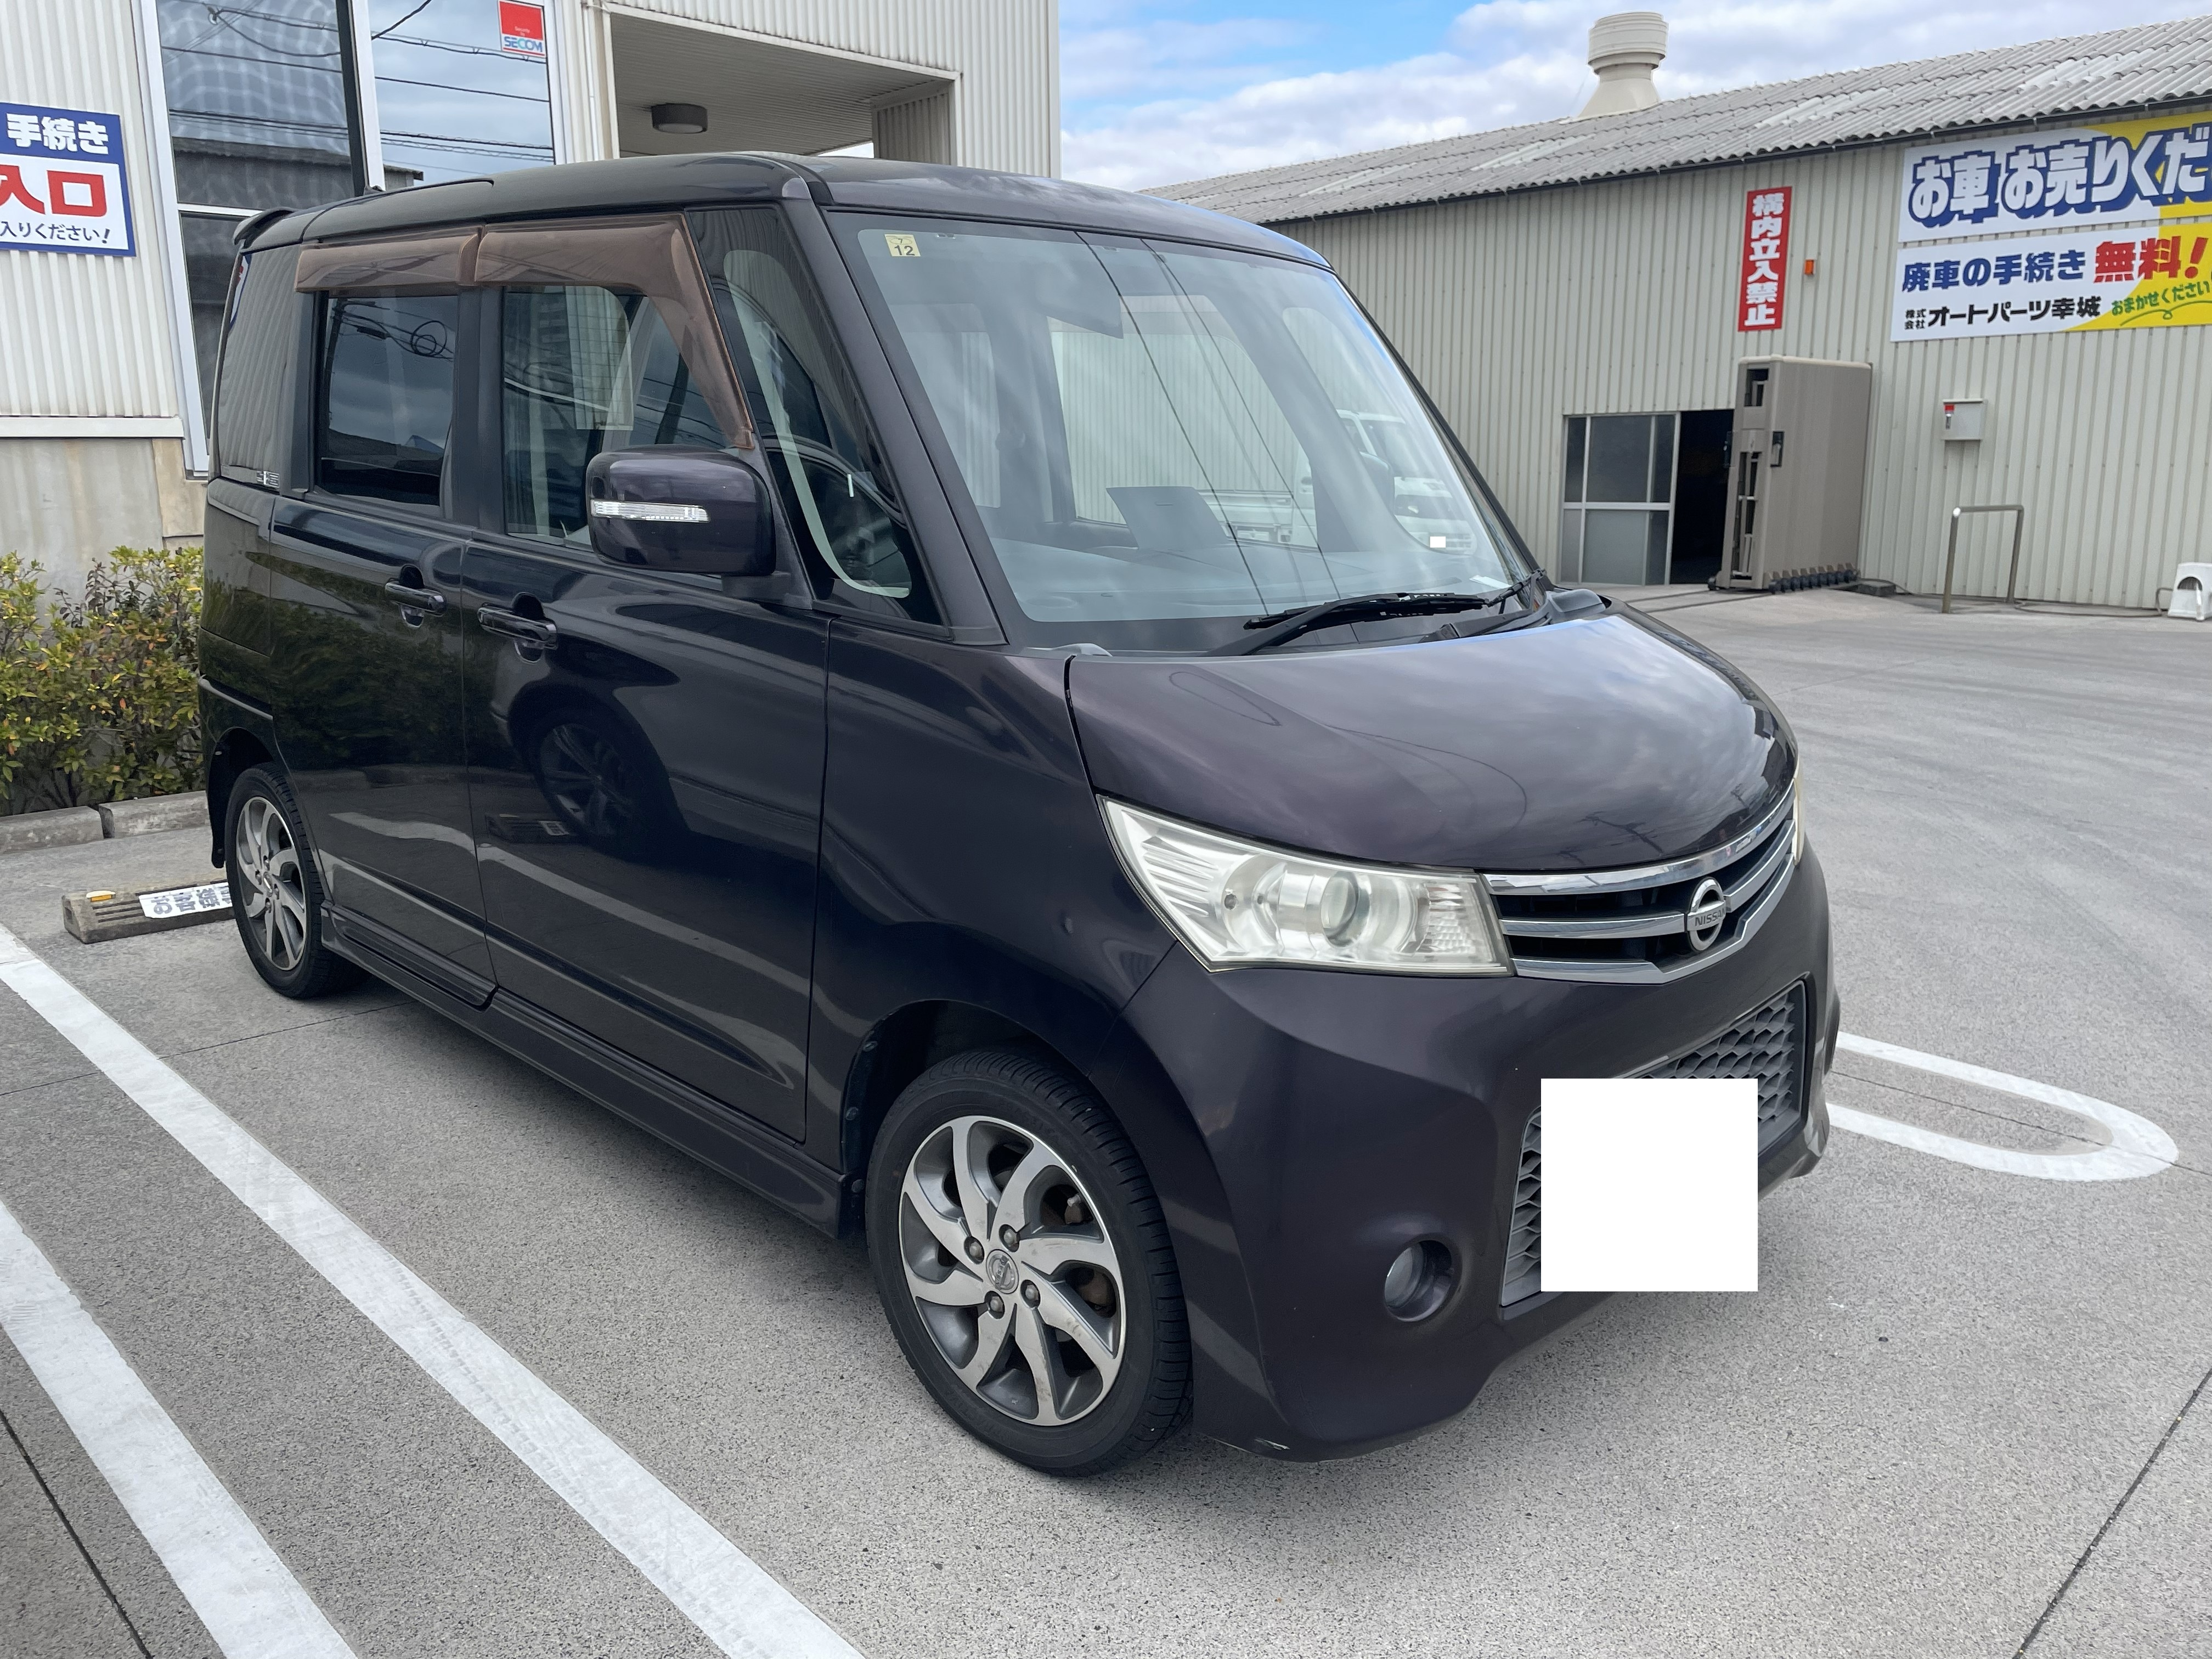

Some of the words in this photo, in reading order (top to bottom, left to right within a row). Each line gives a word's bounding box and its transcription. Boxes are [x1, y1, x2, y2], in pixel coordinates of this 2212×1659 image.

[504, 36, 543, 53] SECOM
[6, 112, 109, 155] 手続き
[0, 164, 108, 217] 入口
[0, 221, 111, 244] 入りください!
[894, 245, 915, 256] 12
[1744, 193, 1785, 327] 構内立入禁止
[1902, 249, 2086, 293] 廃車の手続き
[2094, 235, 2209, 284] 無料!
[1695, 907, 1725, 927] NISSAN
